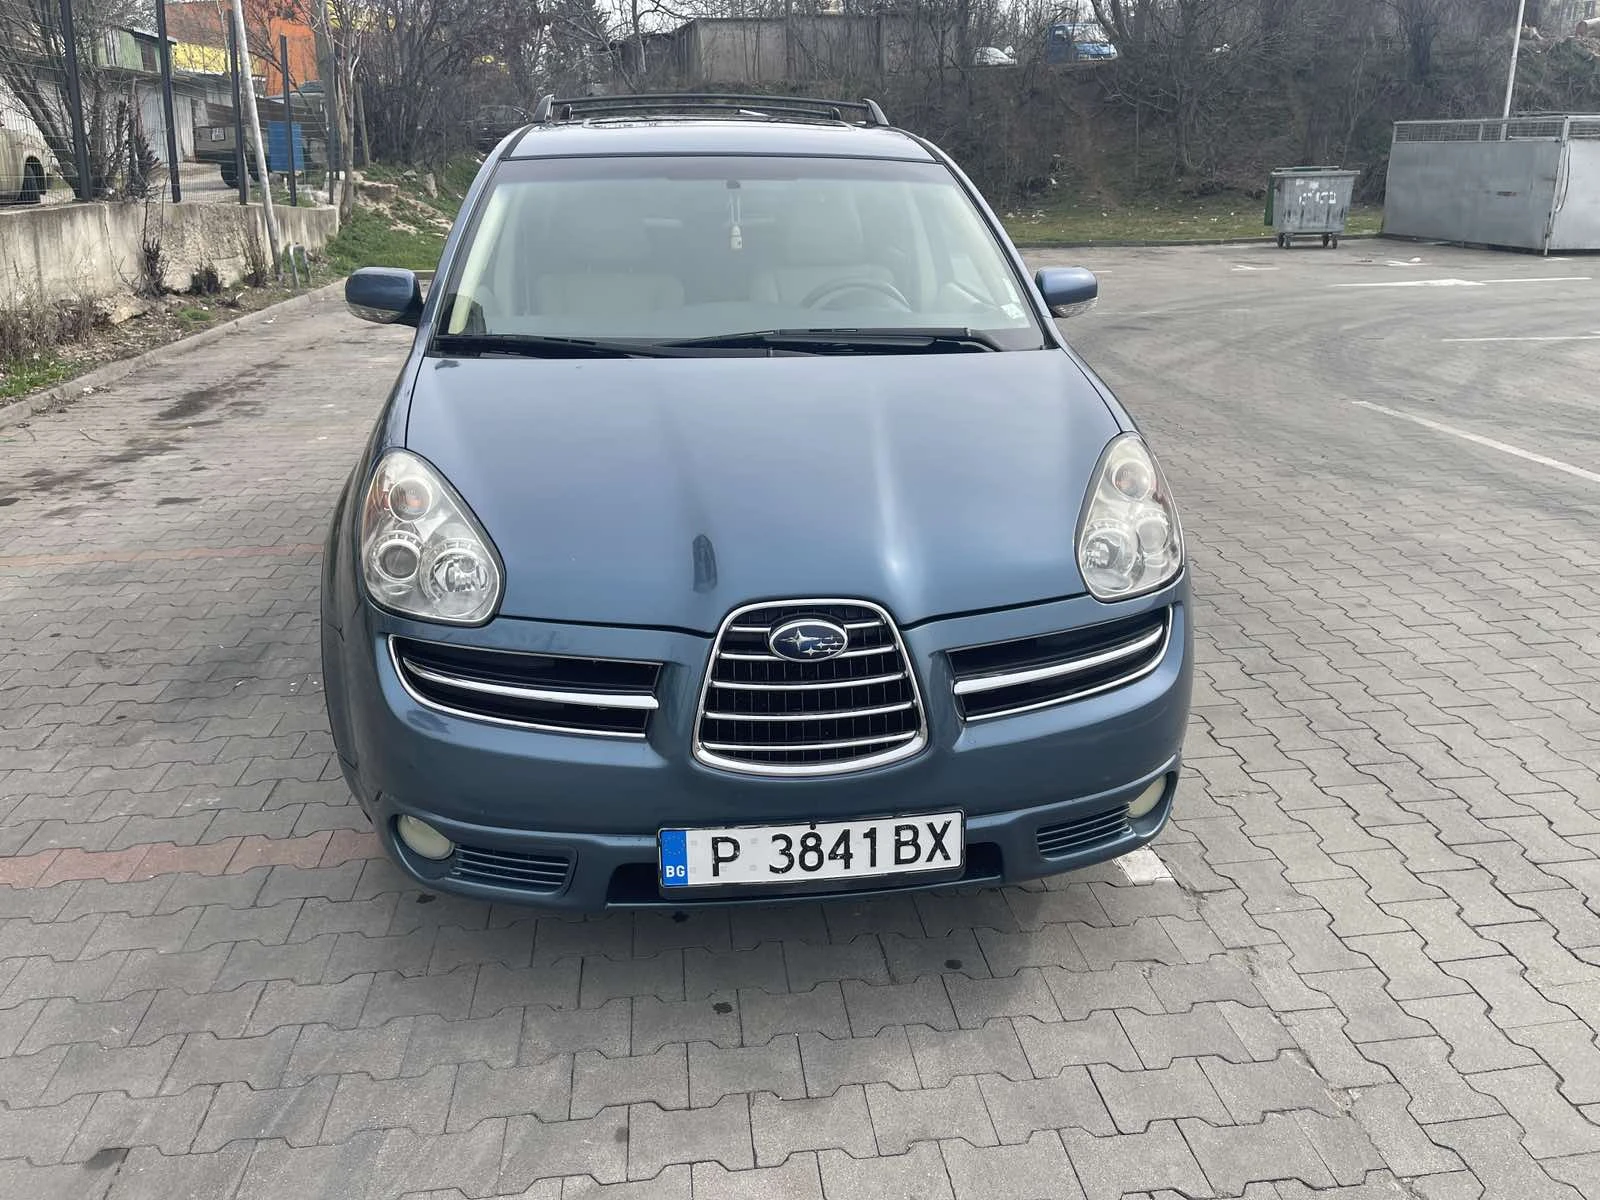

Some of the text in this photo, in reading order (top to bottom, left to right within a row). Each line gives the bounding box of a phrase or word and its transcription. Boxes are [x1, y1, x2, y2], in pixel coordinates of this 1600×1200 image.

[711, 821, 953, 877] P 3841 BX
[666, 865, 686, 878] BG
